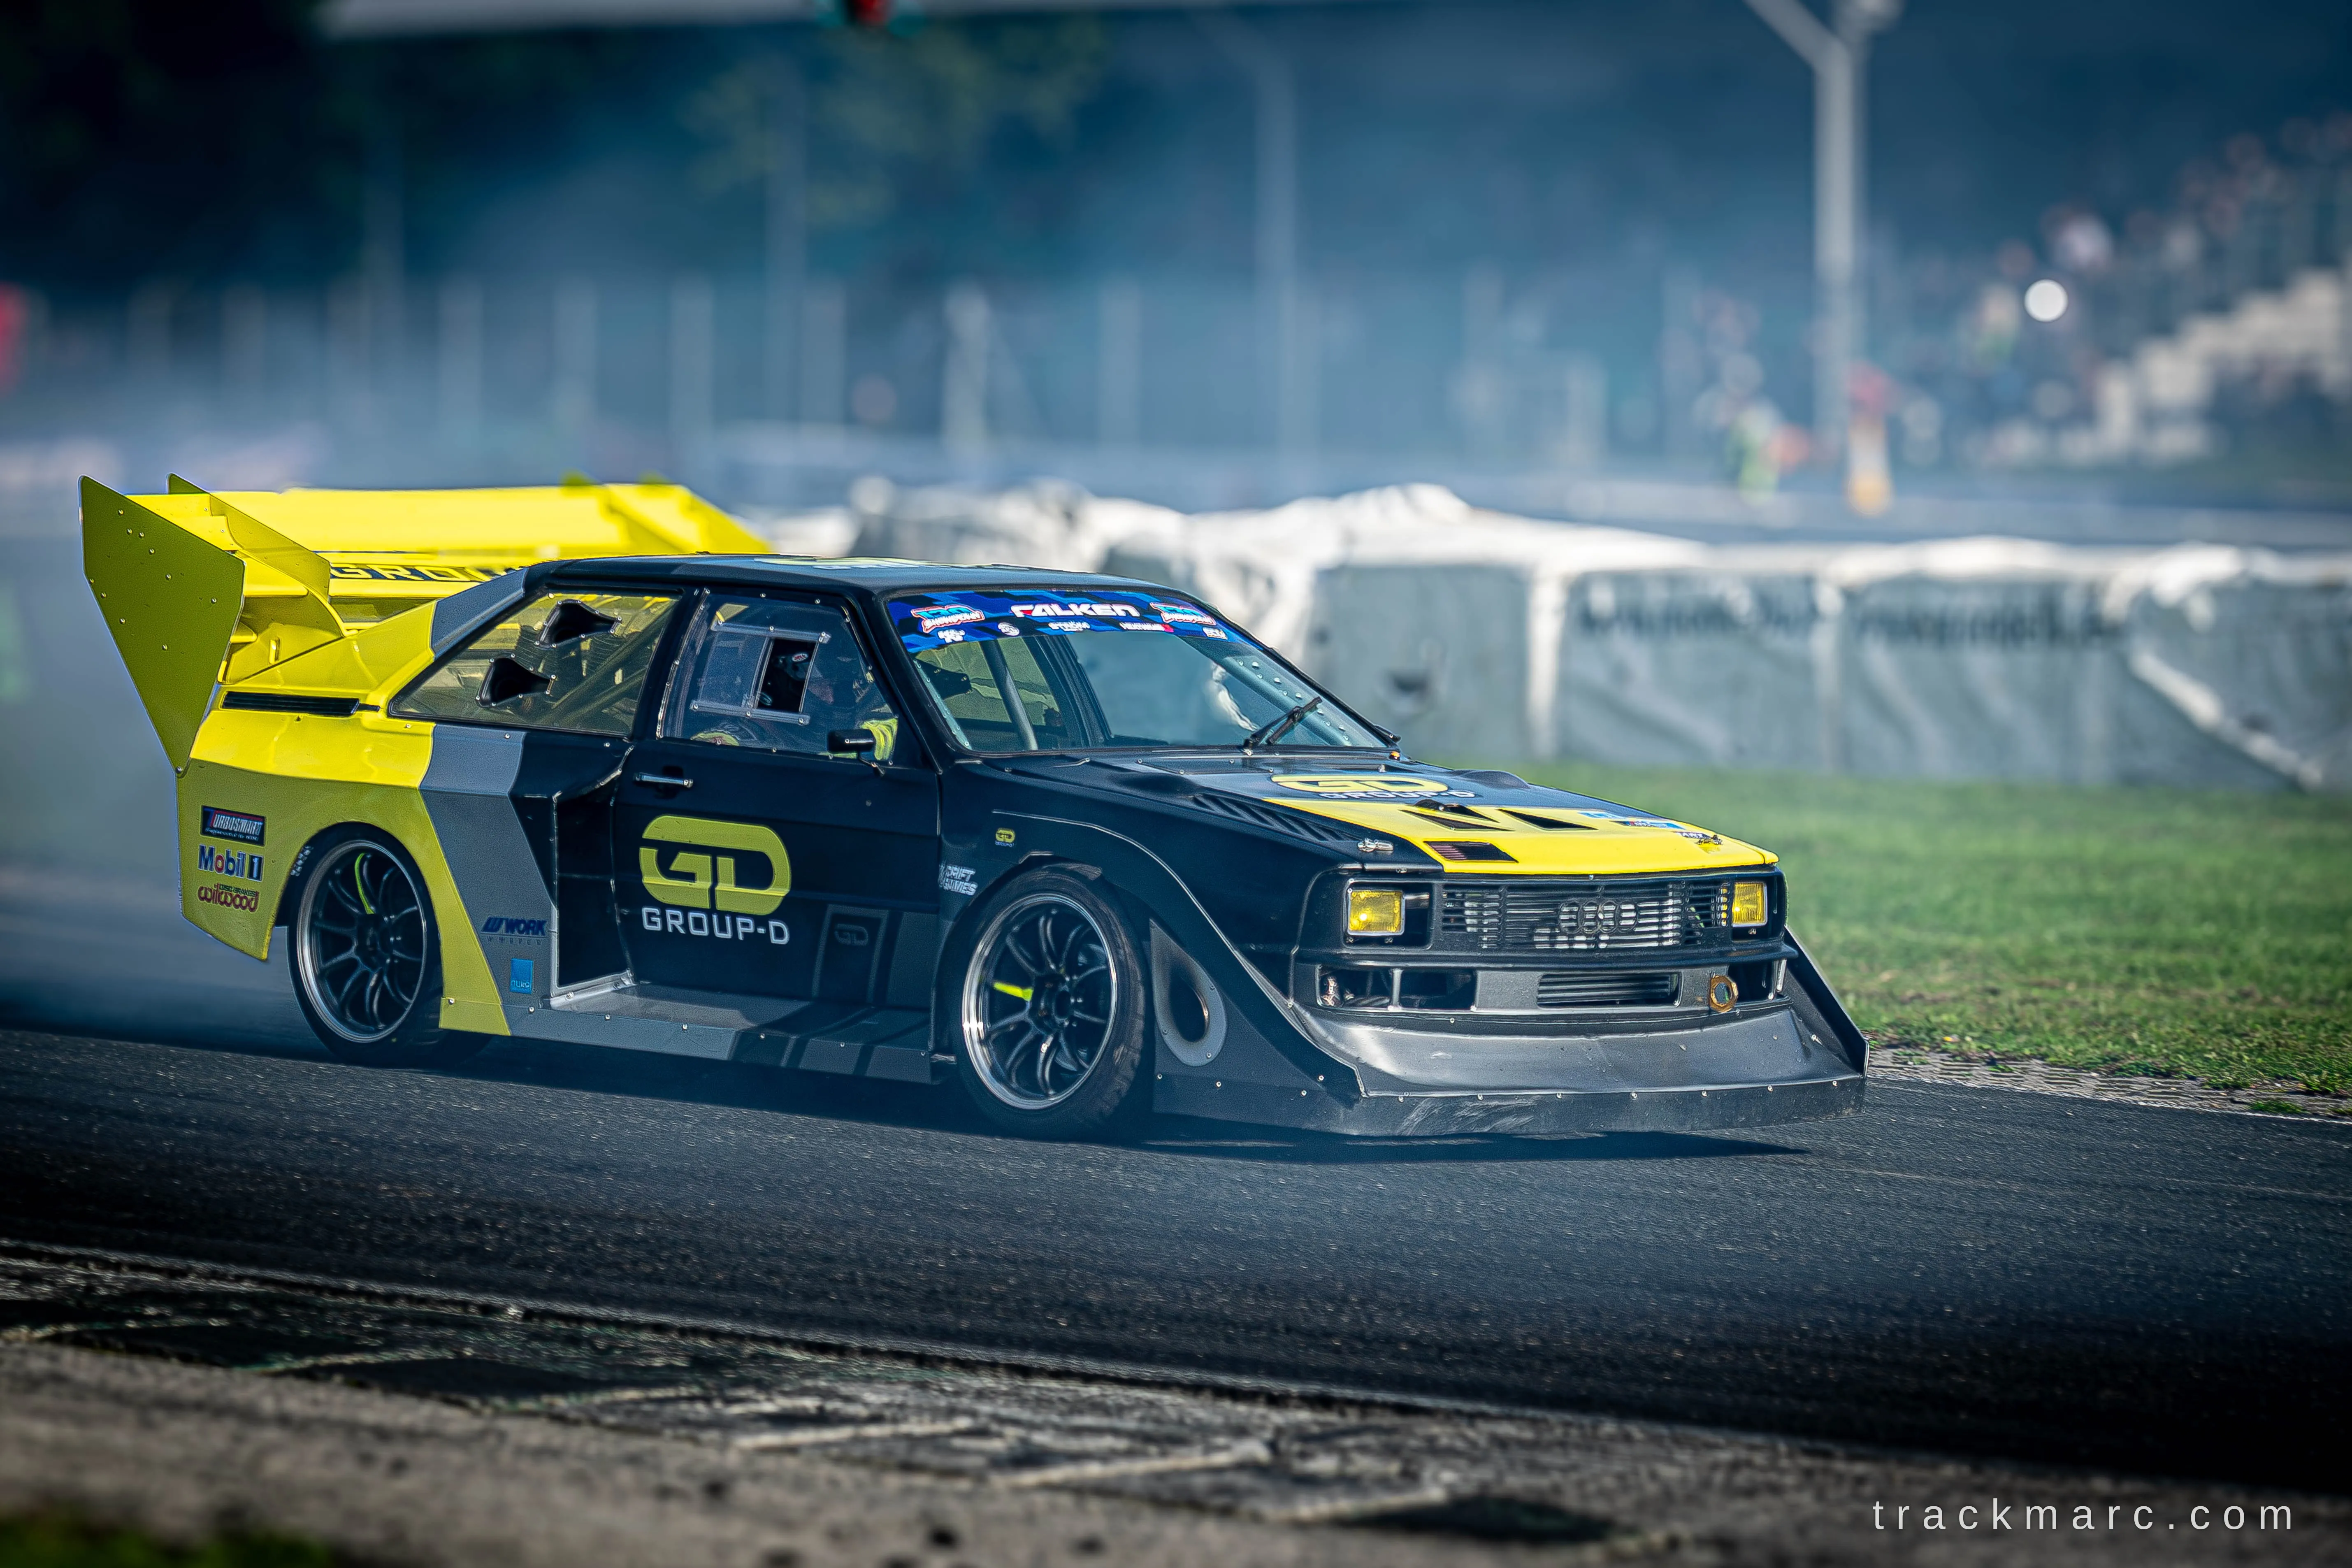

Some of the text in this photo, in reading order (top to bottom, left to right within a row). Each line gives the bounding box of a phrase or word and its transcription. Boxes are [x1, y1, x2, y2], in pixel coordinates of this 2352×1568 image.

[1011, 603, 1140, 617] FALKEN
[1319, 790, 1475, 799] GROUP-D
[198, 845, 246, 879] Mobil
[198, 883, 260, 912] wilwood
[506, 918, 547, 936] WORK
[642, 907, 790, 945] GROUP-D
